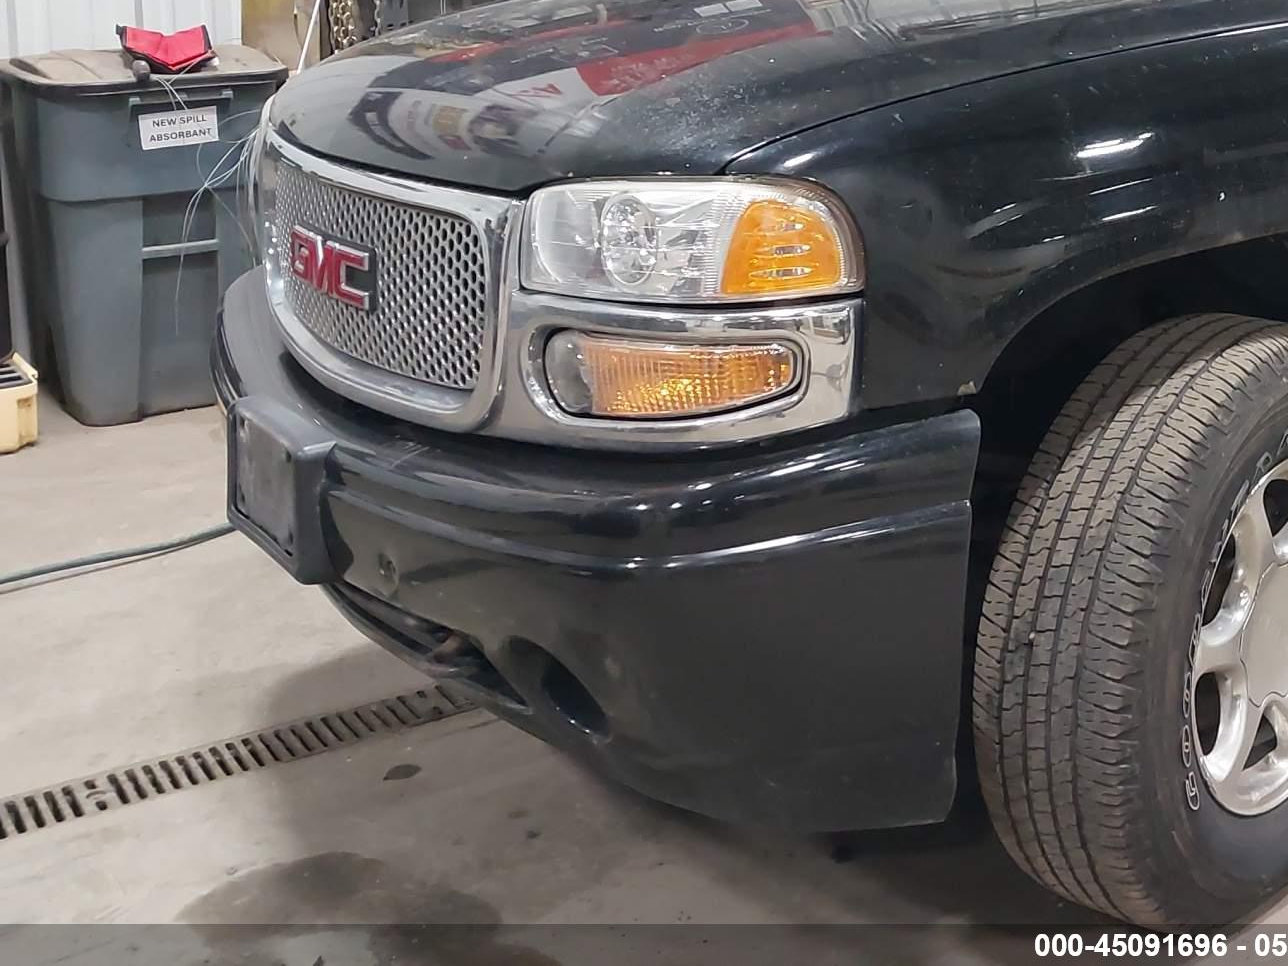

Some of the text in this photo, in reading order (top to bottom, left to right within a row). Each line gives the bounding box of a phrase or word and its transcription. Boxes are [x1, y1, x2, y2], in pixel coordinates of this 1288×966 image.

[152, 114, 207, 127] NEW SPILL
[149, 128, 213, 142] ABSORBANT
[291, 225, 369, 310] GMC
